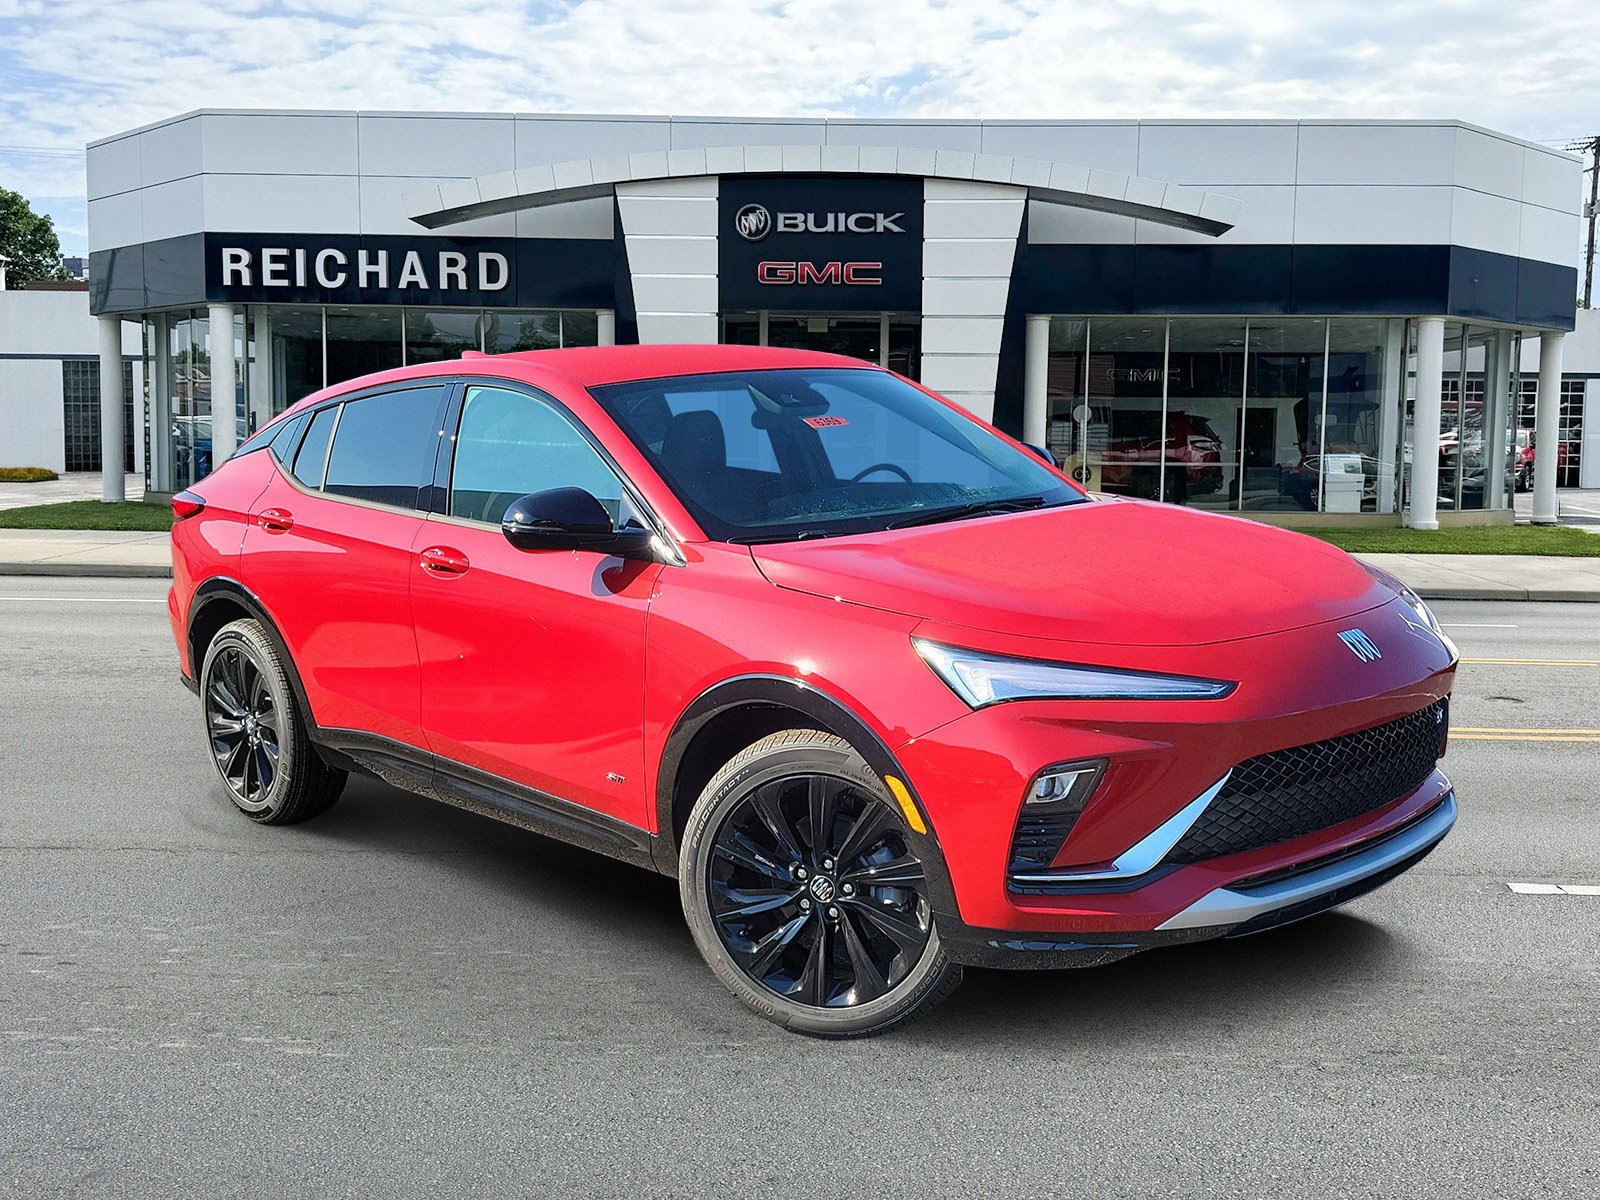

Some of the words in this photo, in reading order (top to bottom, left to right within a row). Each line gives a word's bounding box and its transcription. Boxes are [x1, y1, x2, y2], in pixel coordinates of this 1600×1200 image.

[777, 212, 906, 233] BUICK
[222, 247, 510, 291] REICHARD
[758, 261, 882, 285] GMC
[1106, 368, 1180, 382] GMC
